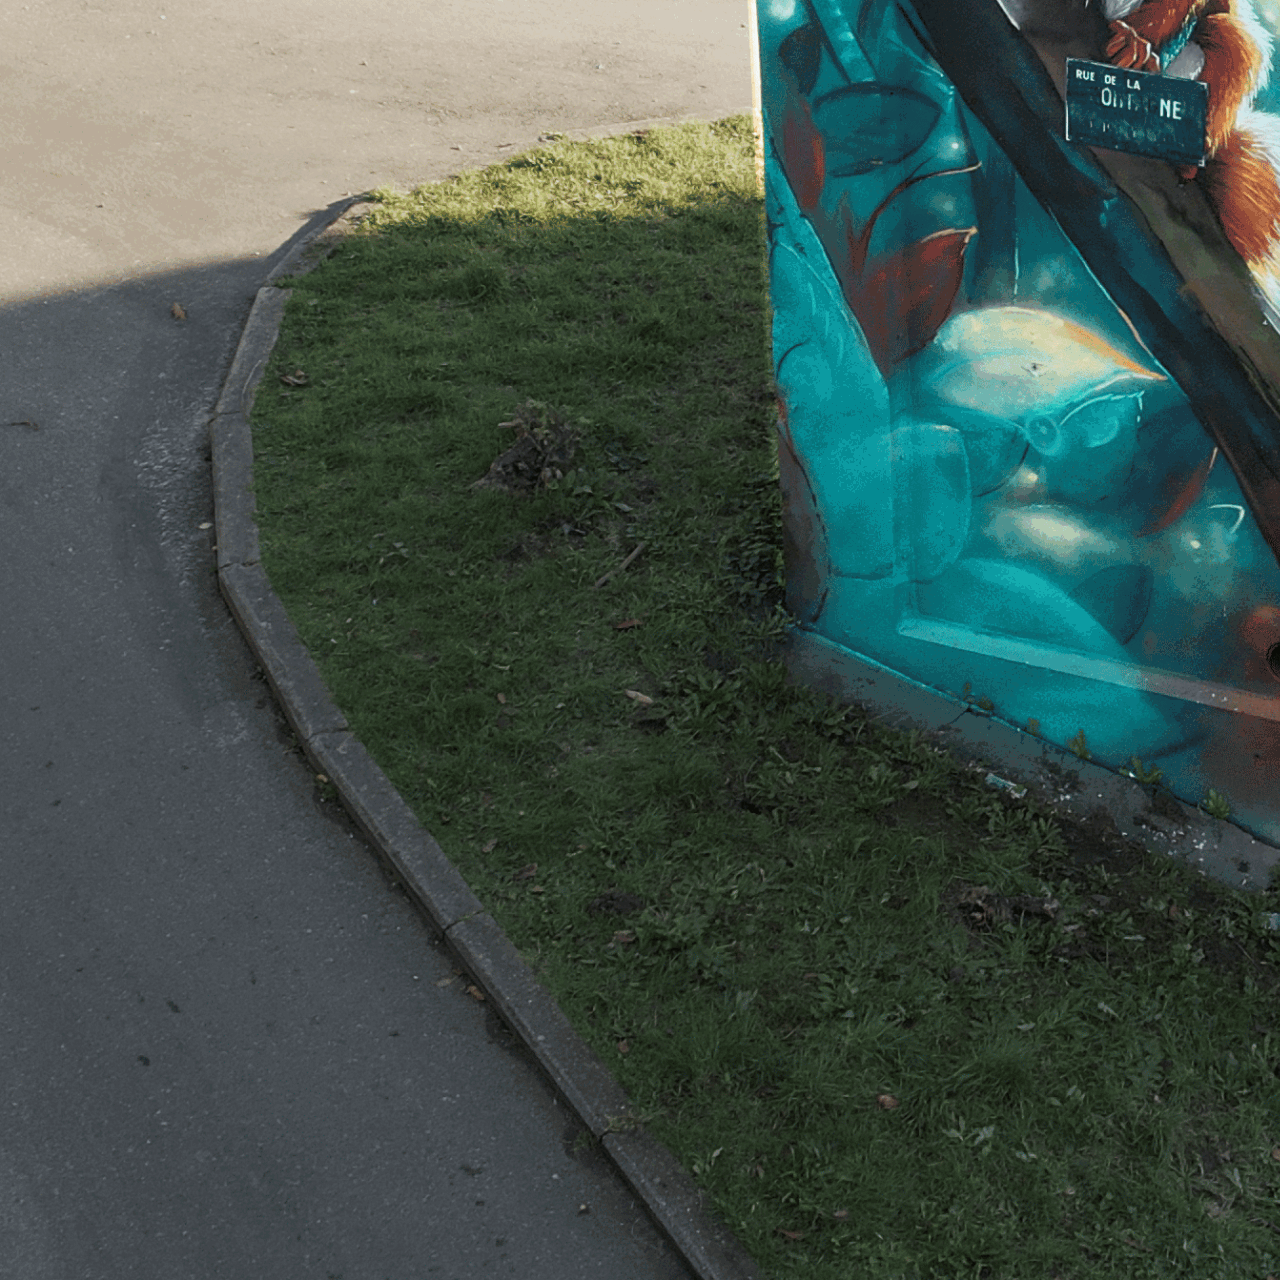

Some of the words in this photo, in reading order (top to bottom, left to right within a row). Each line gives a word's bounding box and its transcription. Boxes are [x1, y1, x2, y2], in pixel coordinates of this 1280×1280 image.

[1075, 69, 1096, 82] RUE
[1104, 74, 1117, 86] DE
[1126, 79, 1141, 91] LA
